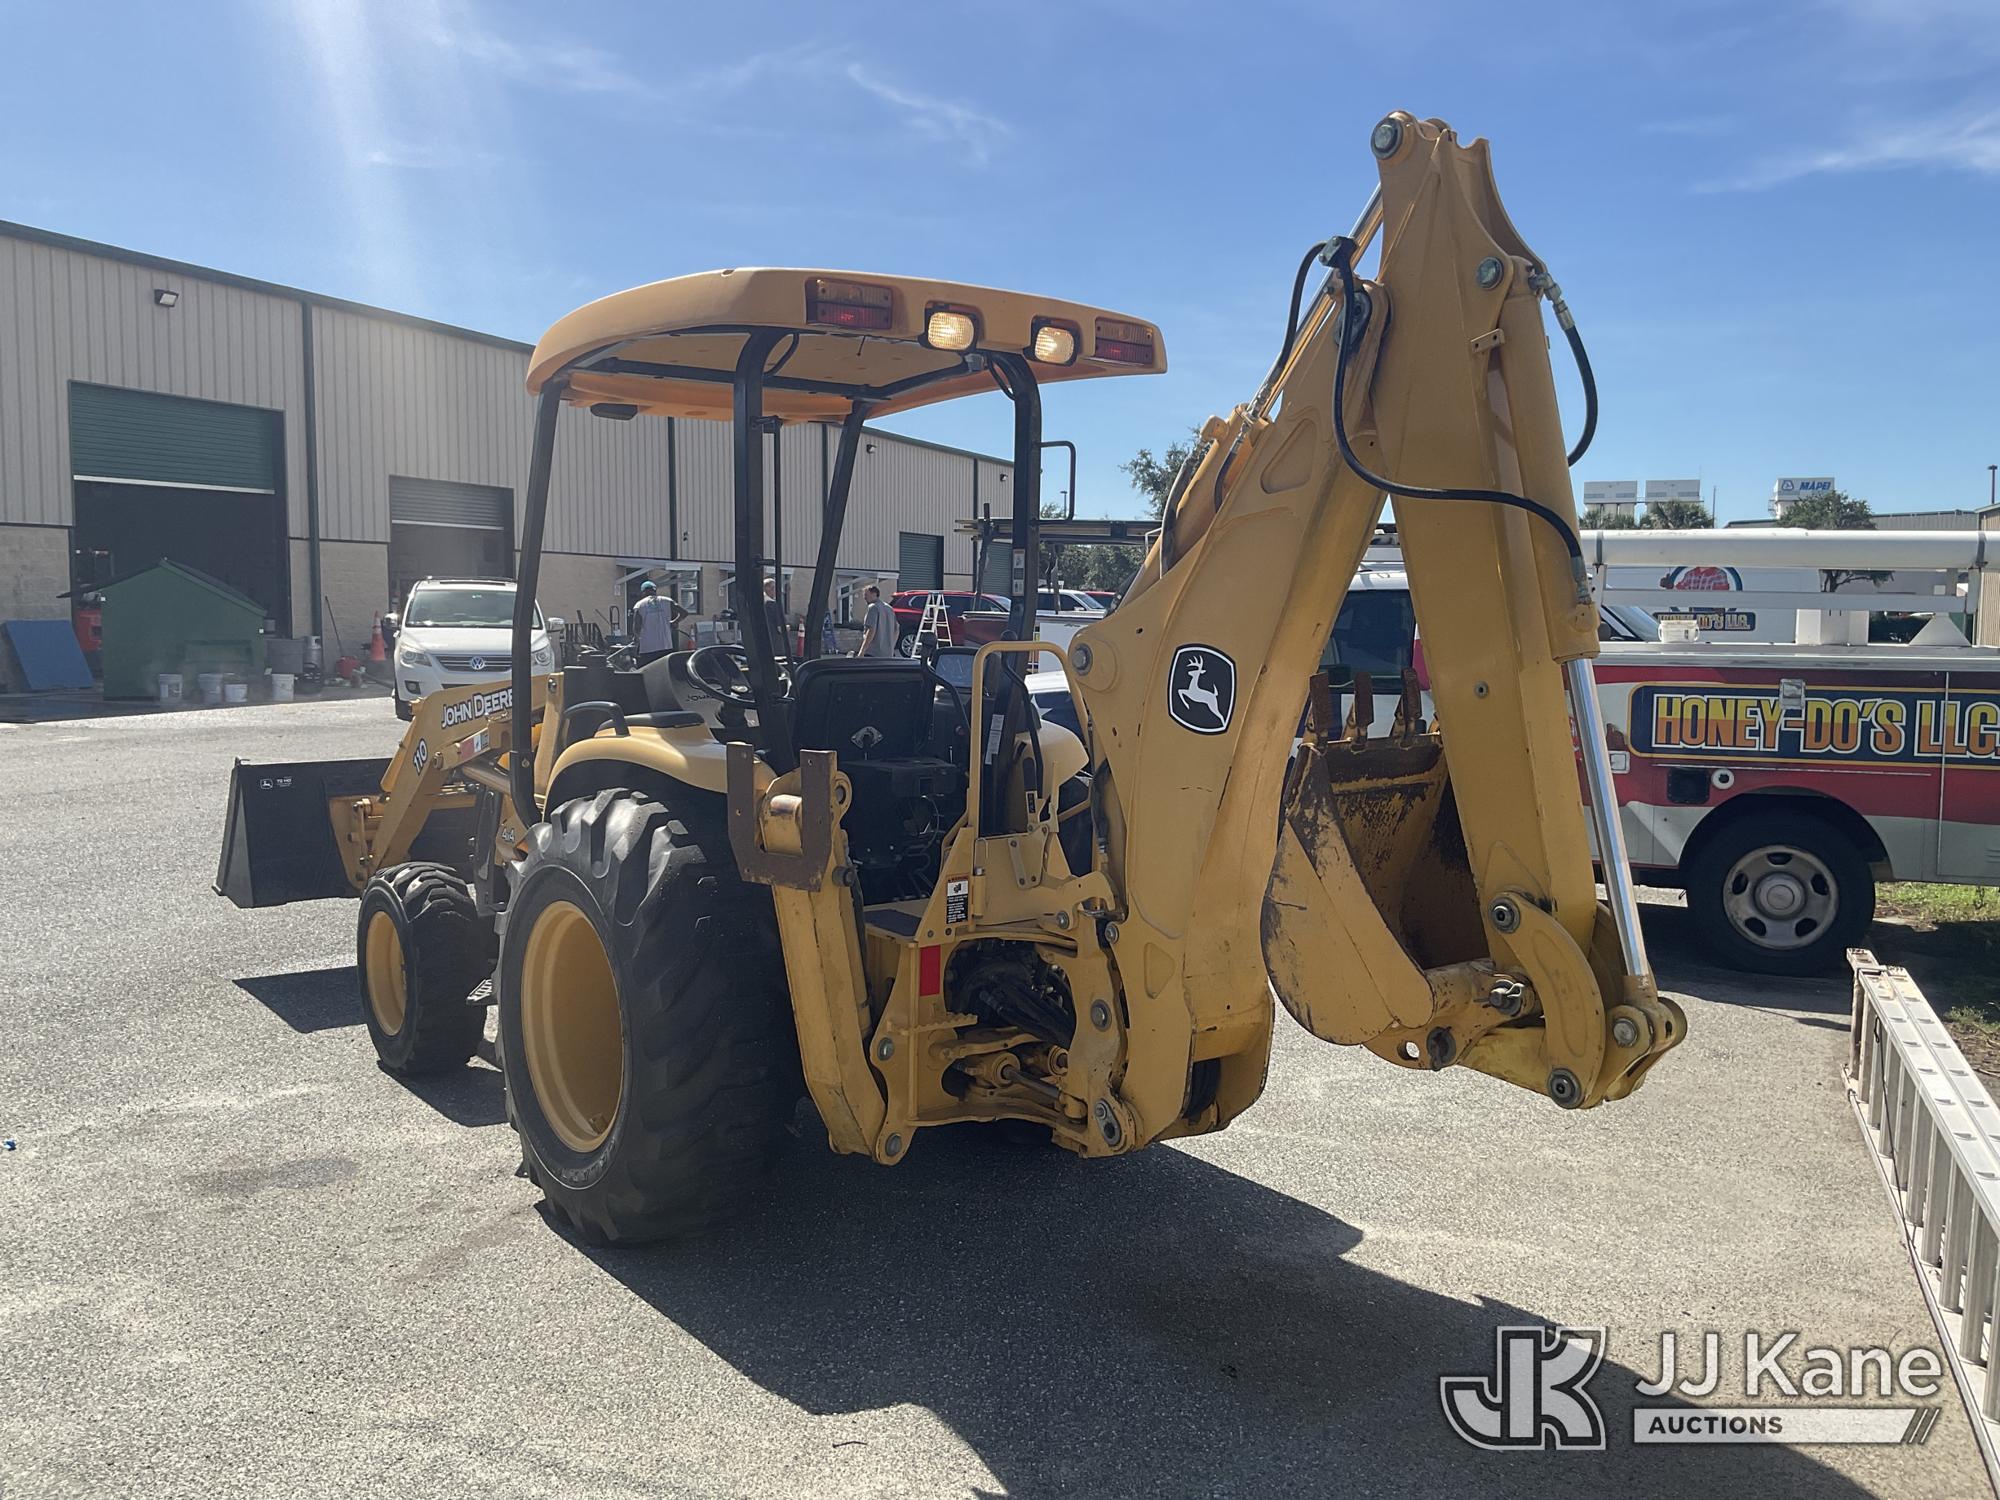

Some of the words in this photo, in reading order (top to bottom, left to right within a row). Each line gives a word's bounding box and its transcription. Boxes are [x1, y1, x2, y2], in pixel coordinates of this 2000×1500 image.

[1799, 481, 1831, 491] MAPEI
[441, 699, 473, 730] JOHN
[1652, 694, 1906, 756] HONEY-DO'S
[413, 739, 428, 775] 110
